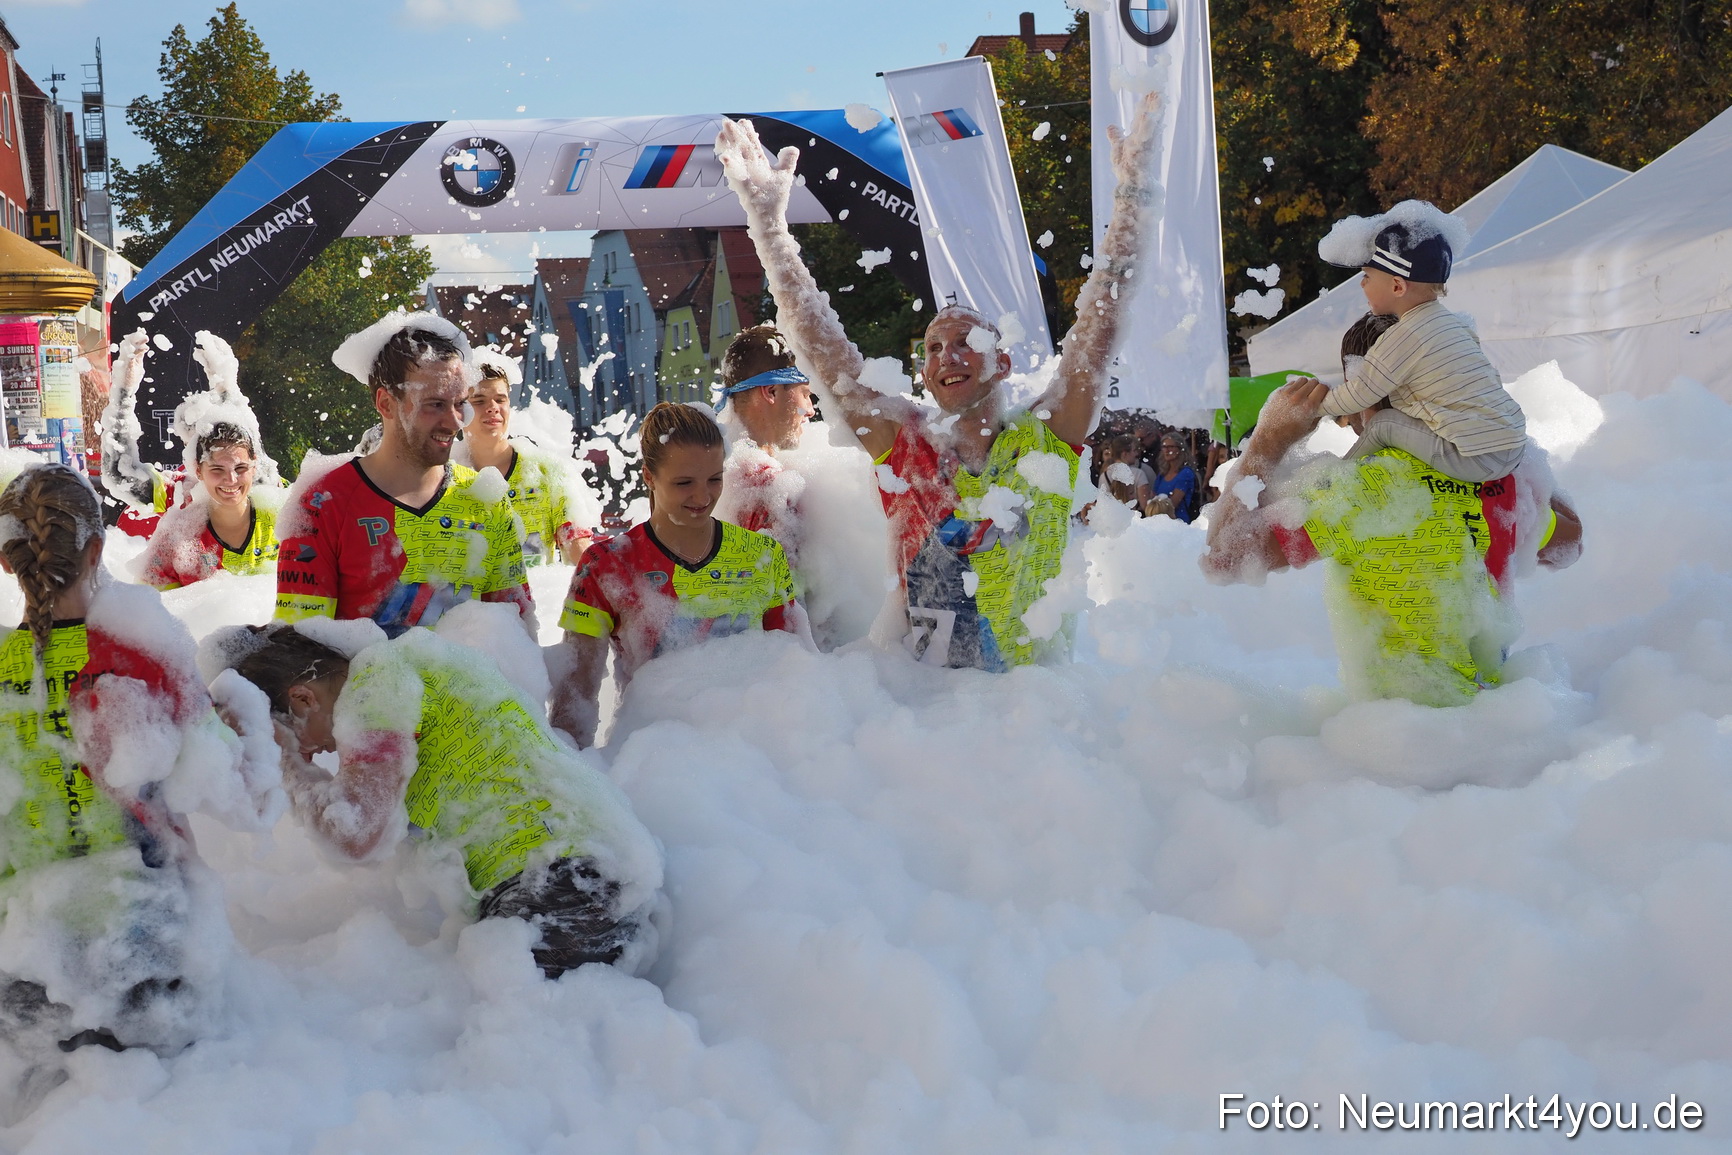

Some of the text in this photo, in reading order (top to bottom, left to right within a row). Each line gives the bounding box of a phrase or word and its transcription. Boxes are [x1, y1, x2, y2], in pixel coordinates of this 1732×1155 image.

[862, 181, 919, 226] PARTL
[149, 195, 312, 313] PARTL NEUMARKT
[7, 345, 35, 354] SUNRISE
[20, 380, 37, 389] JAHRE
[1421, 475, 1468, 496] Team
[911, 615, 938, 661] 7
